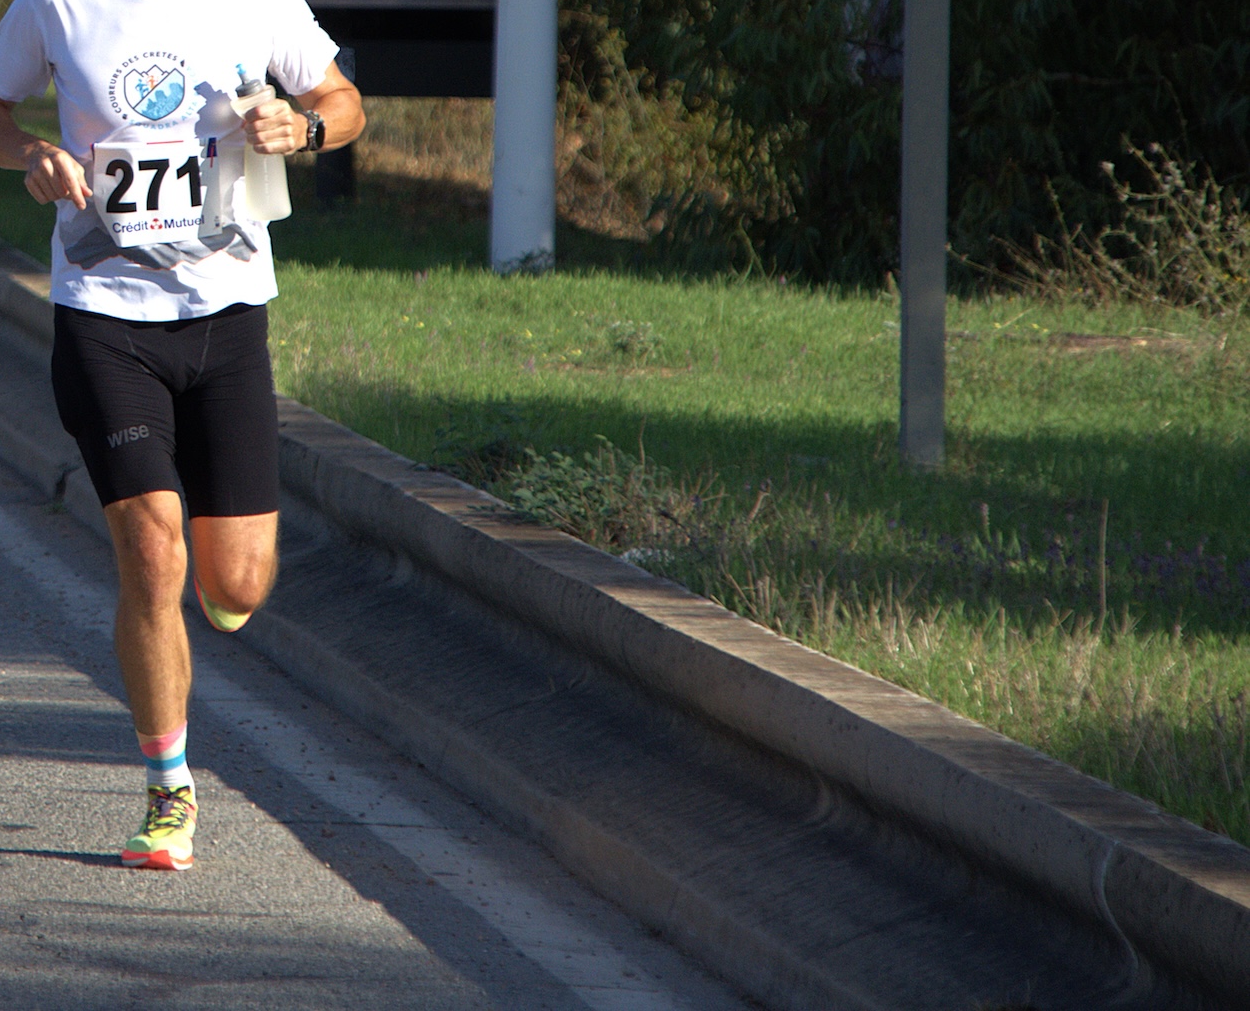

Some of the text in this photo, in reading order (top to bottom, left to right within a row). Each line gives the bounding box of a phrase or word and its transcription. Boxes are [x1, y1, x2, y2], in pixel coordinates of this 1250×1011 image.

[109, 68, 122, 114] COUREURS
[122, 55, 139, 68] DES
[105, 156, 202, 213] 271
[112, 215, 205, 234] Crédit Mutuel
